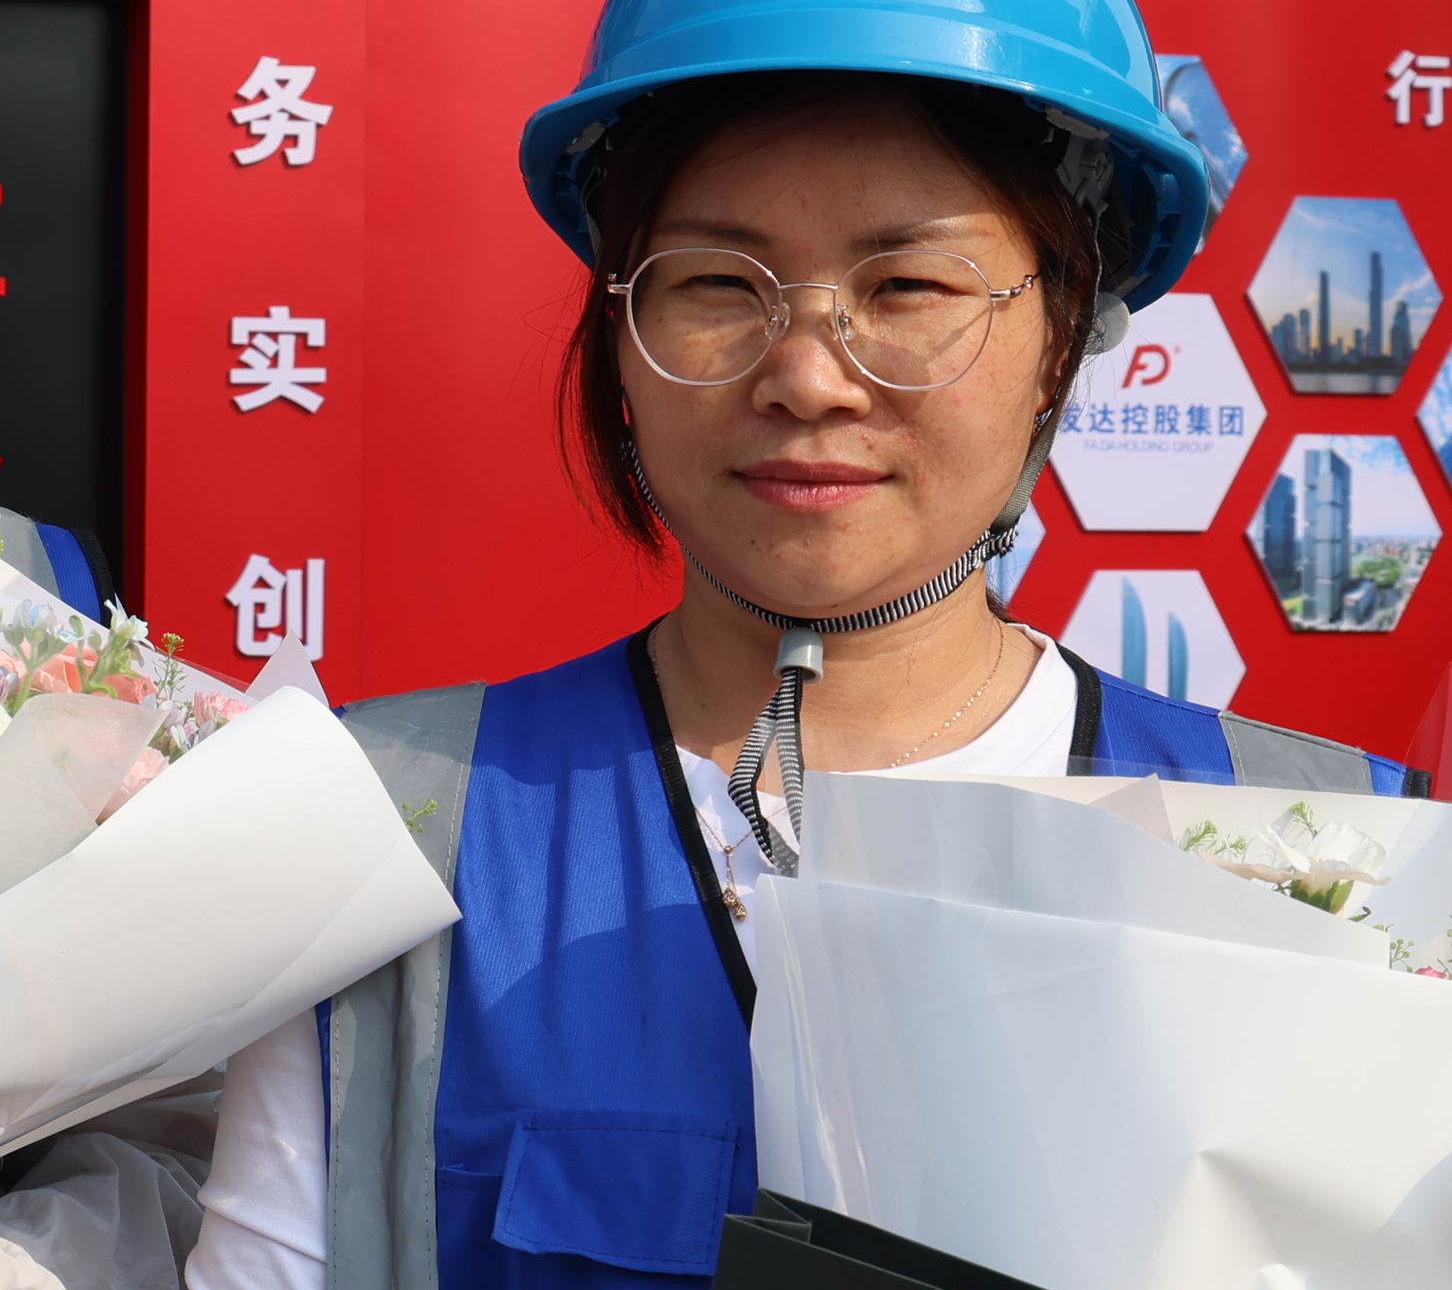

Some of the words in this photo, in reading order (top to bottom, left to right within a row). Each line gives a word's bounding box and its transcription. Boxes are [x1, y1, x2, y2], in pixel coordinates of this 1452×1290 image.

[1059, 404, 1244, 437] 发达控股集团
[1119, 440, 1170, 453] HOLDING
[1174, 440, 1215, 453] GROUP
